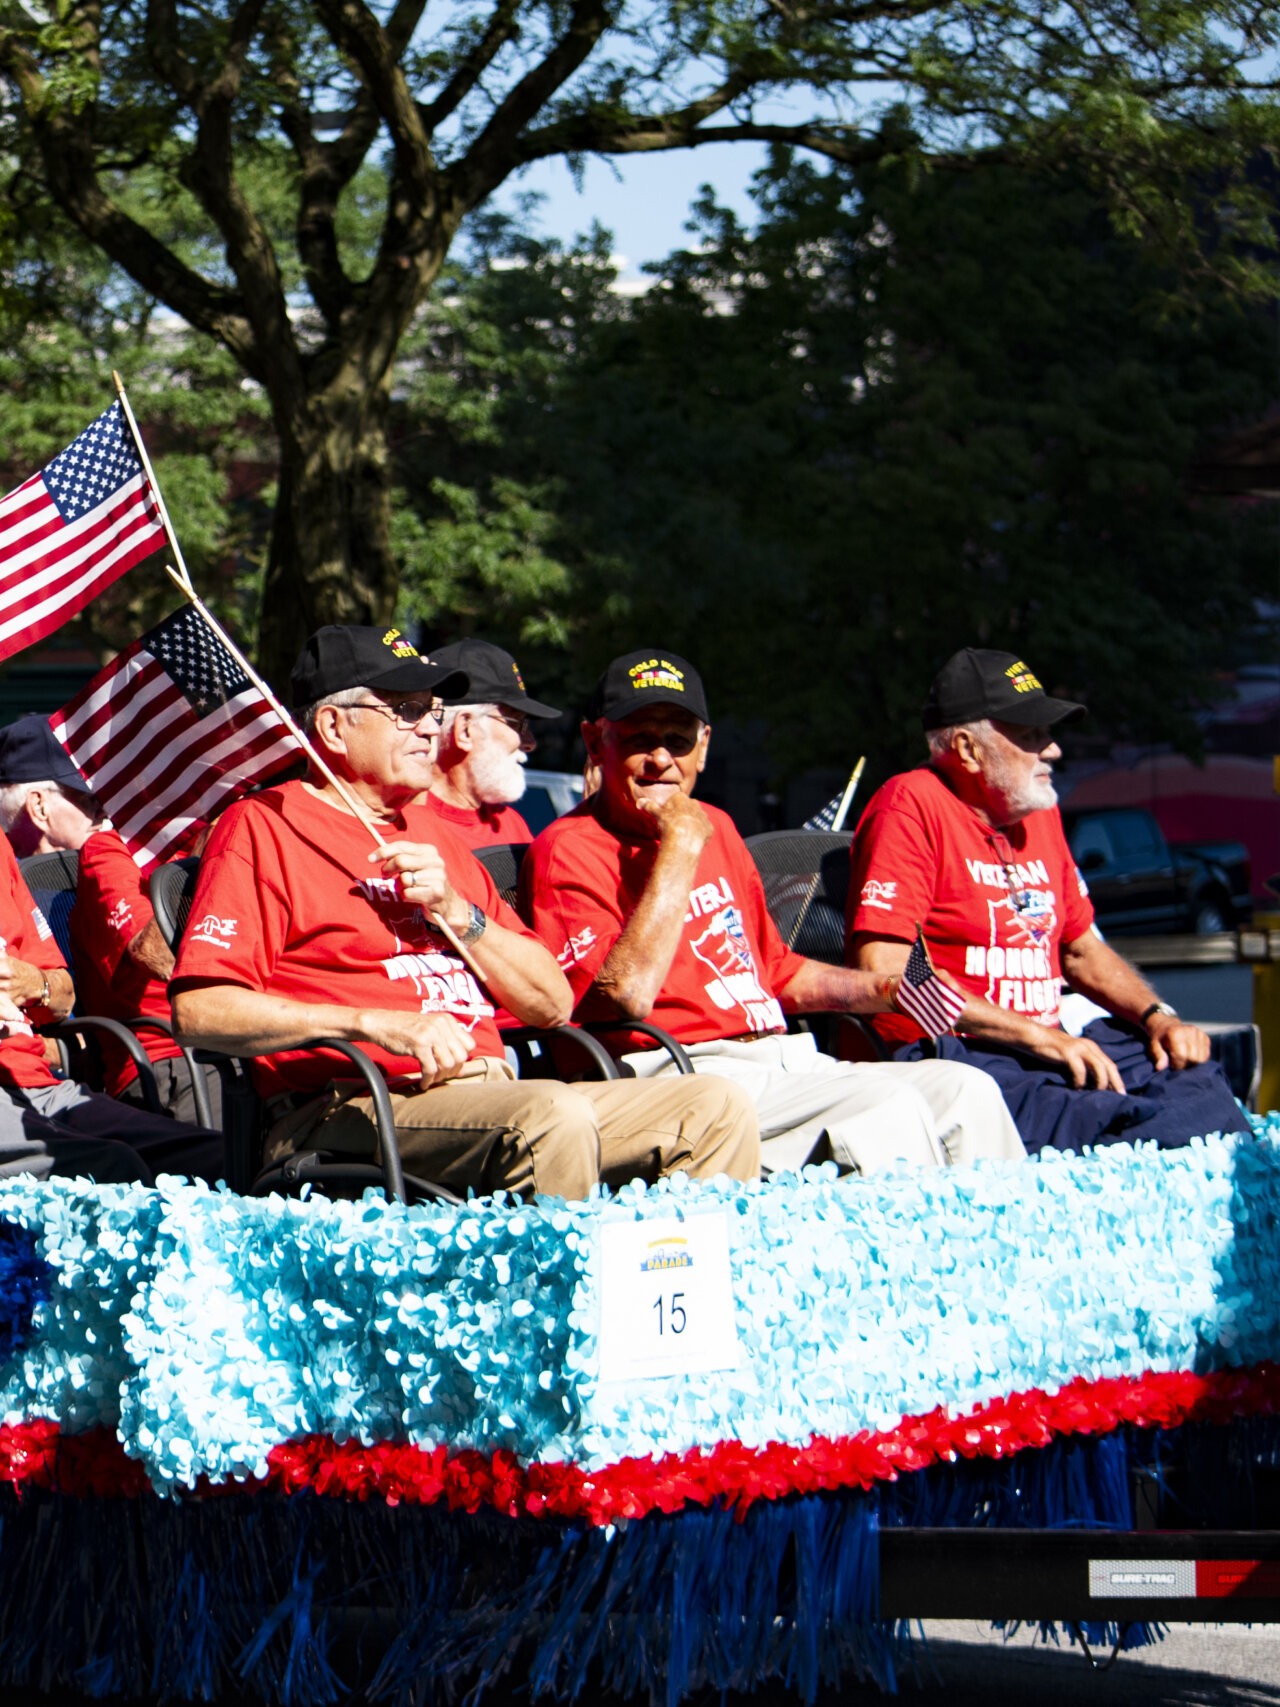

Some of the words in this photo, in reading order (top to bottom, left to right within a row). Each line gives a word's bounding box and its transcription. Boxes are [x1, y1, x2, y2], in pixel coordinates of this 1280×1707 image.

[628, 659, 659, 678] COLD
[661, 659, 685, 679] WAR
[632, 676, 685, 692] VETERAN
[965, 945, 1047, 980] HONOR
[999, 977, 1062, 1013] FLIGHT
[646, 1256, 689, 1270] PARADE
[652, 1292, 687, 1336] 15
[1110, 1573, 1176, 1584] SURE-TRAC
